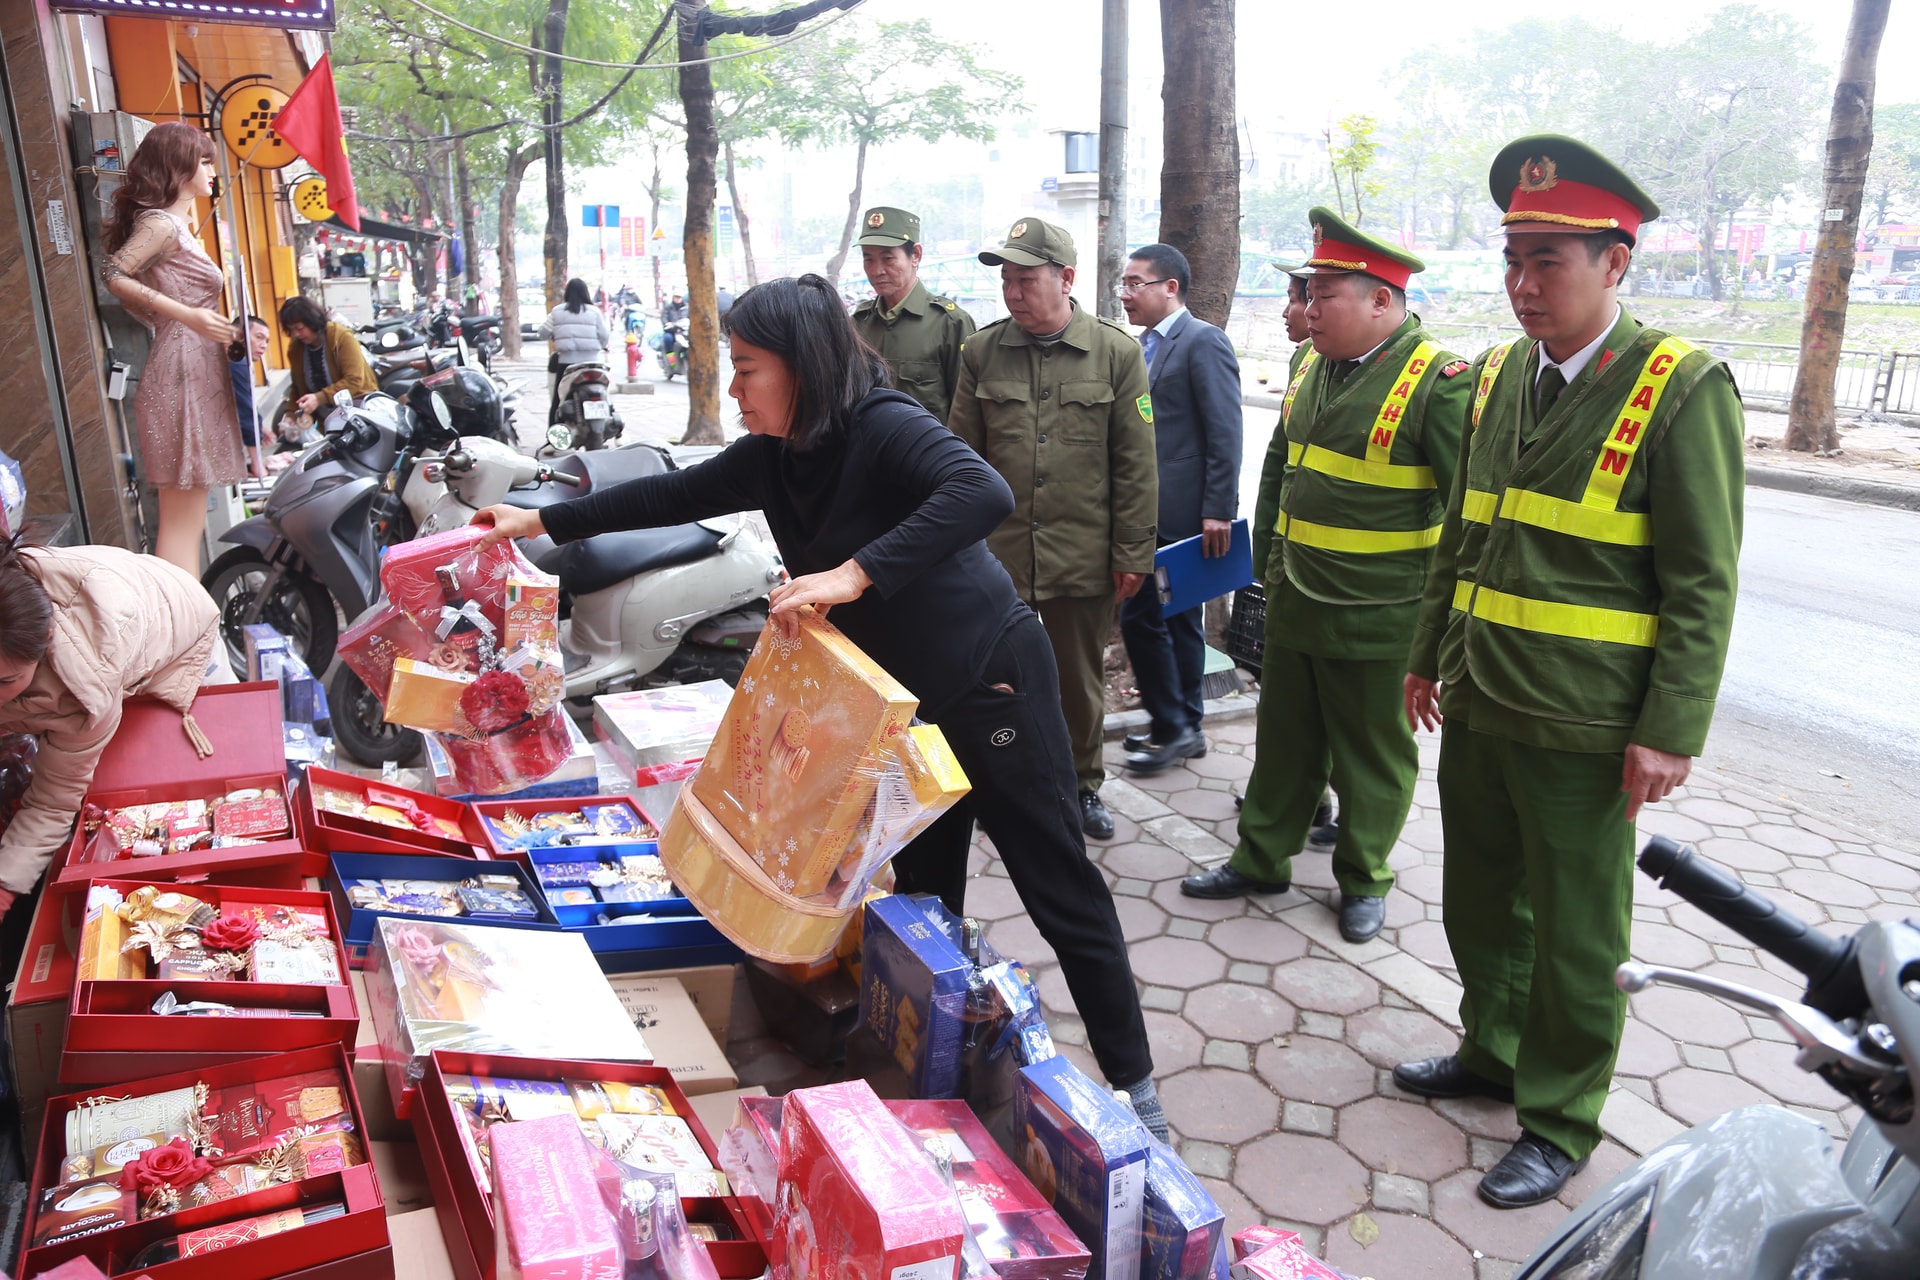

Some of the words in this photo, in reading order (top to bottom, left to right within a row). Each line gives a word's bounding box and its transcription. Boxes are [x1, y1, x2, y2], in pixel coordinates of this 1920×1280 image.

[1372, 358, 1425, 448] CAHN
[1599, 354, 1675, 476] CAHN
[539, 1176, 565, 1218] JASMINE
[45, 1220, 126, 1246] CAPPUCCINO
[60, 1212, 115, 1232] CHOCOLATE
